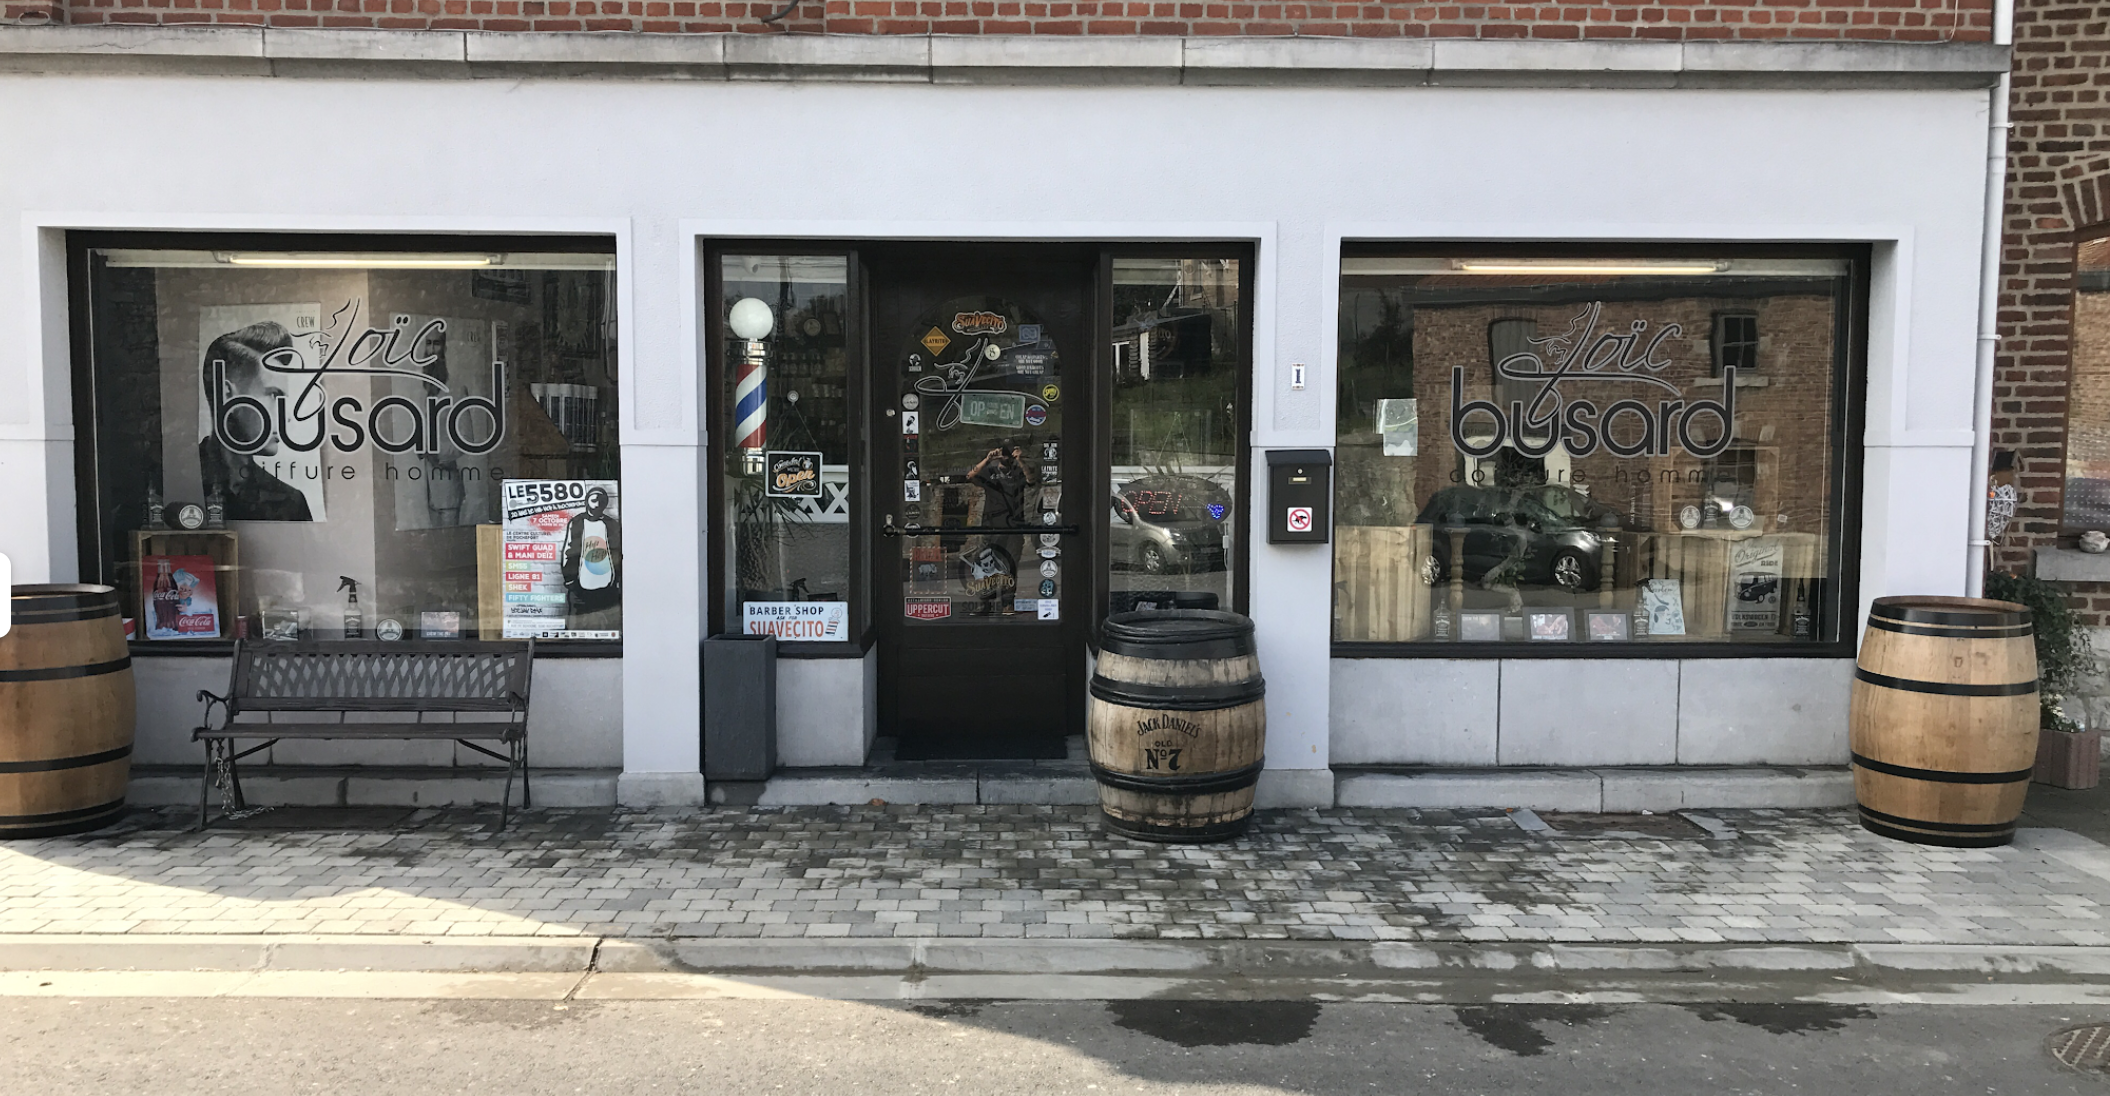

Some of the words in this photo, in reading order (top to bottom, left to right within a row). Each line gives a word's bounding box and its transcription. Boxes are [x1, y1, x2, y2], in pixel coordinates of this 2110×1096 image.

[296, 316, 315, 328] CREW
[213, 360, 506, 455] busard
[1452, 365, 1735, 458] busard
[216, 462, 356, 480] oiffure
[385, 462, 505, 480] homme
[776, 470, 815, 488] Open
[1615, 465, 1731, 483] homme
[1121, 490, 1182, 515] OPEN
[508, 543, 530, 551] SWIFT
[532, 543, 553, 551] GUAD
[749, 606, 792, 615] BARBER
[795, 606, 824, 615] SHOP
[907, 604, 949, 615] UPPERCUT
[749, 620, 824, 637] SUAVECITO
[1137, 717, 1162, 736] JACK
[1162, 713, 1202, 738] DANIEL'S
